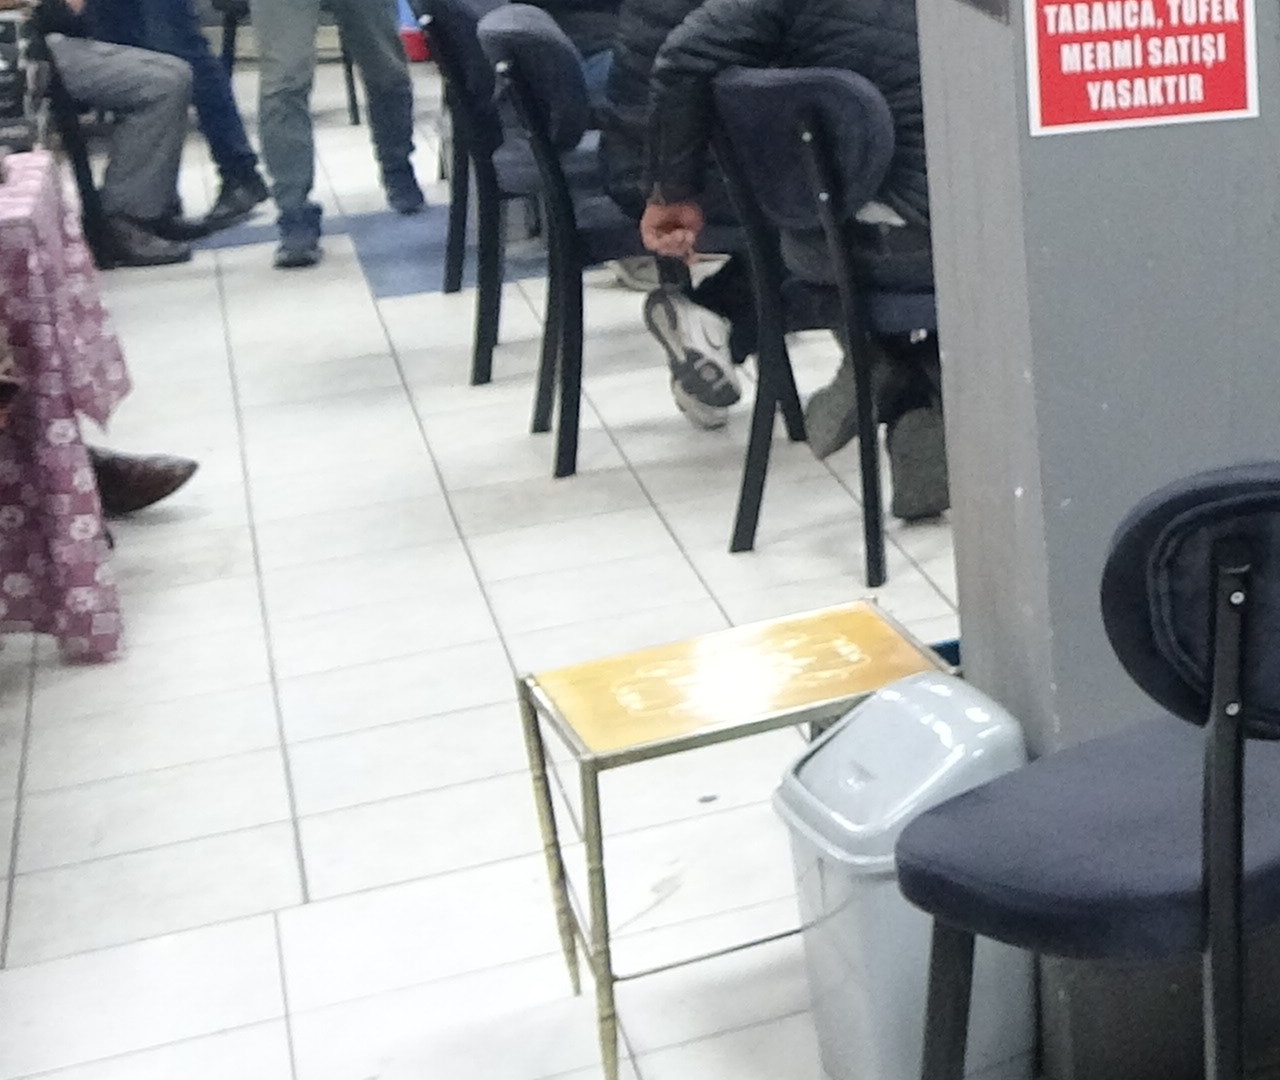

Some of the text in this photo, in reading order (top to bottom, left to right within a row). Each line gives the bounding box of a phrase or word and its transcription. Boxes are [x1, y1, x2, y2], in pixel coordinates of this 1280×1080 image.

[1060, 32, 1226, 74] MERMİ SATIŞI
[1086, 73, 1205, 111] YASAKTIR
